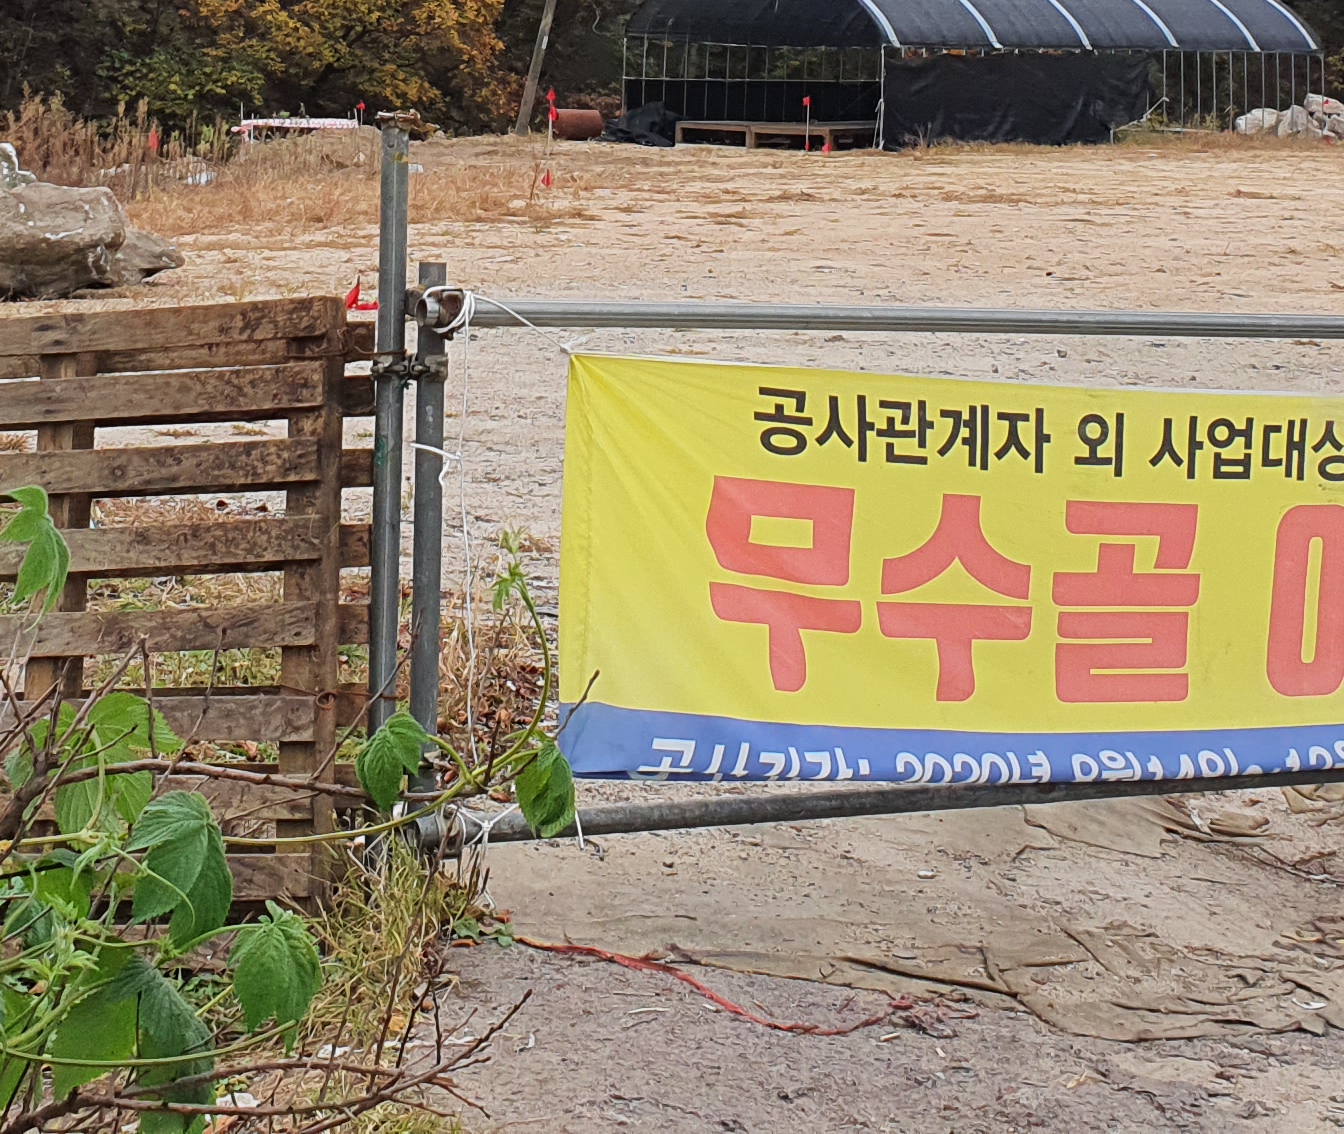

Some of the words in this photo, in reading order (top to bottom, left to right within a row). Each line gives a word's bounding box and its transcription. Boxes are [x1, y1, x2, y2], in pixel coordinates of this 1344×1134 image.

[754, 386, 1051, 473] 공사관계자
[1074, 413, 1124, 477] 외
[706, 475, 1201, 703] 무수골
